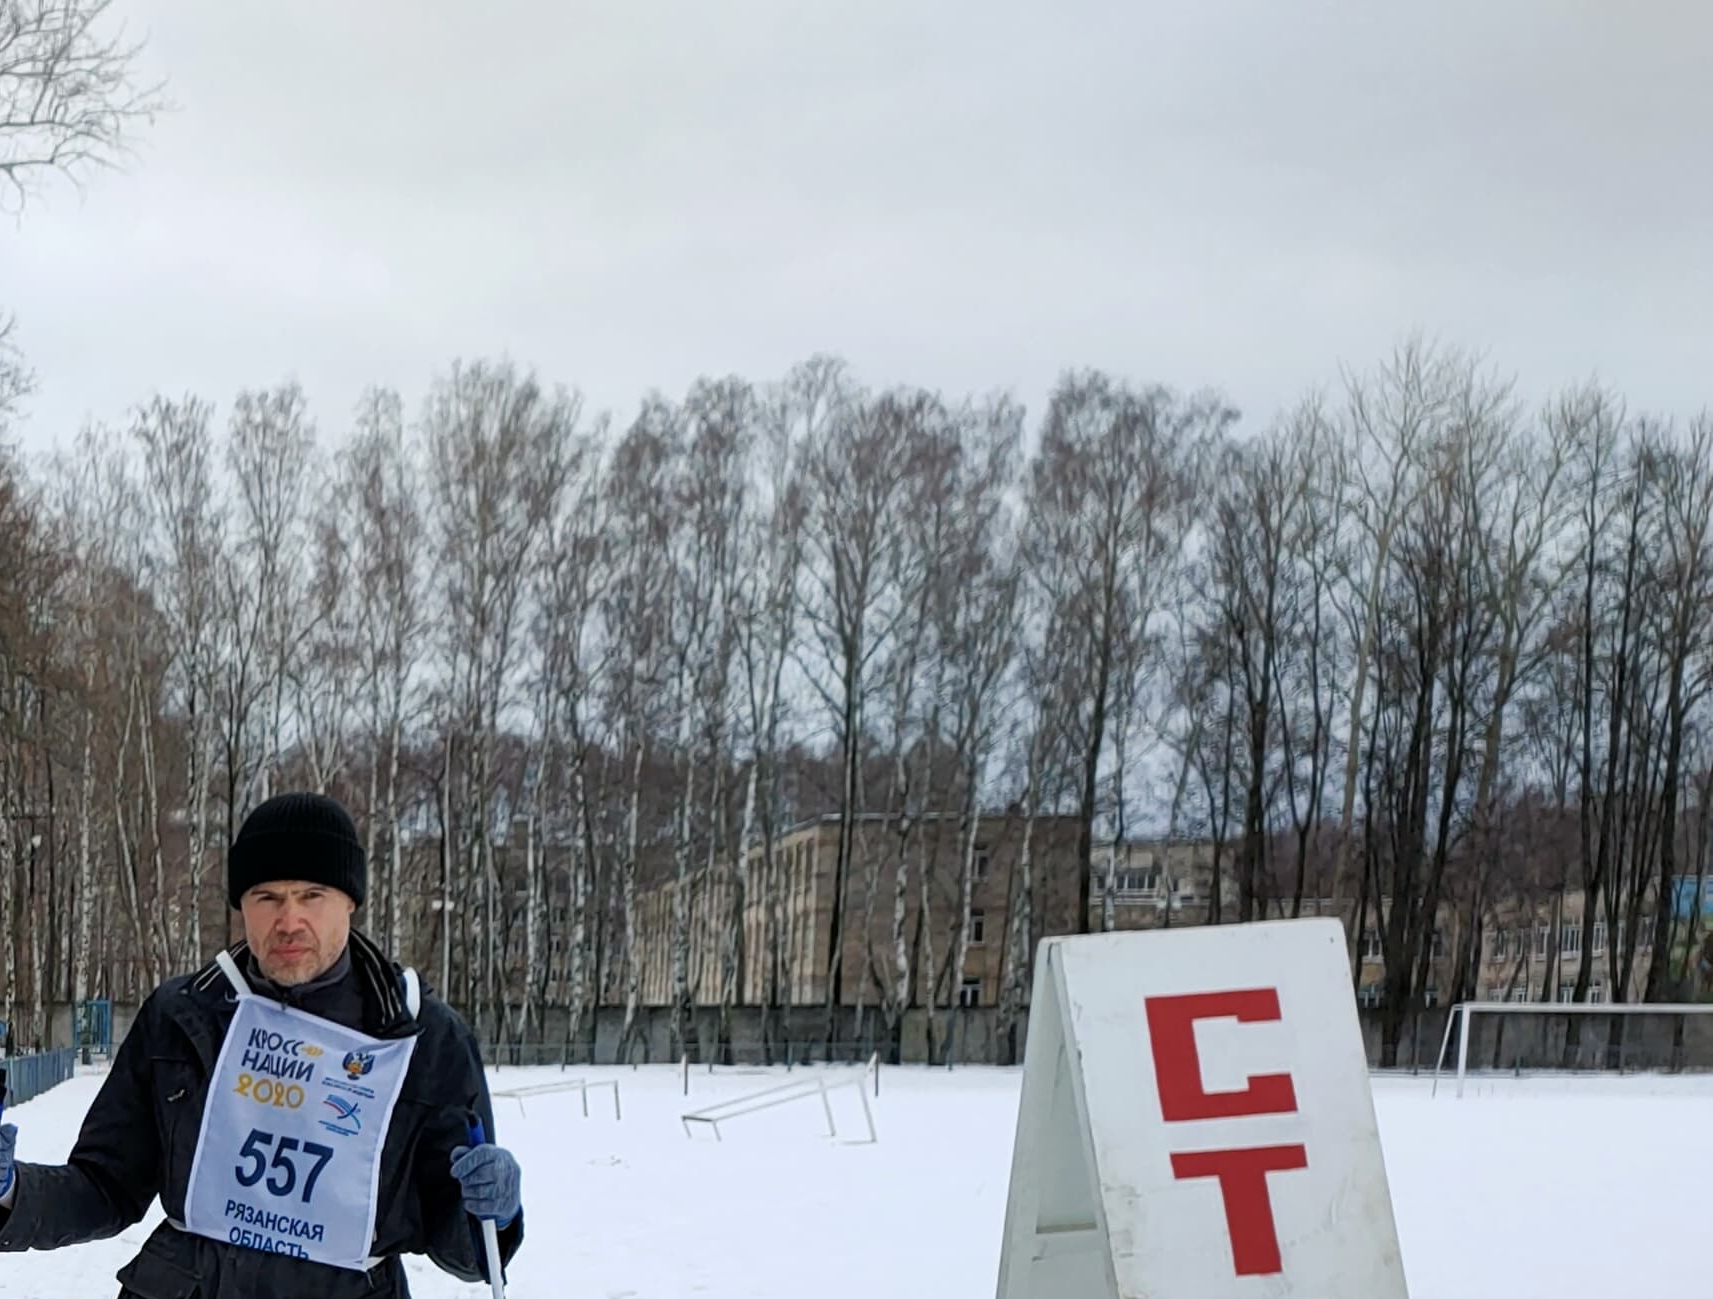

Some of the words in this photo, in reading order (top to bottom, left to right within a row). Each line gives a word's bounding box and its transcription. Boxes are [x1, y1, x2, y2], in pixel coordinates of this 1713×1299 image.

[248, 1027, 304, 1056] КРОСС
[241, 1048, 315, 1083] НАЦИИ
[233, 1073, 304, 1109] 2020
[235, 1128, 334, 1203] 557
[225, 1199, 324, 1242] РЯЗАНСКАЯ
